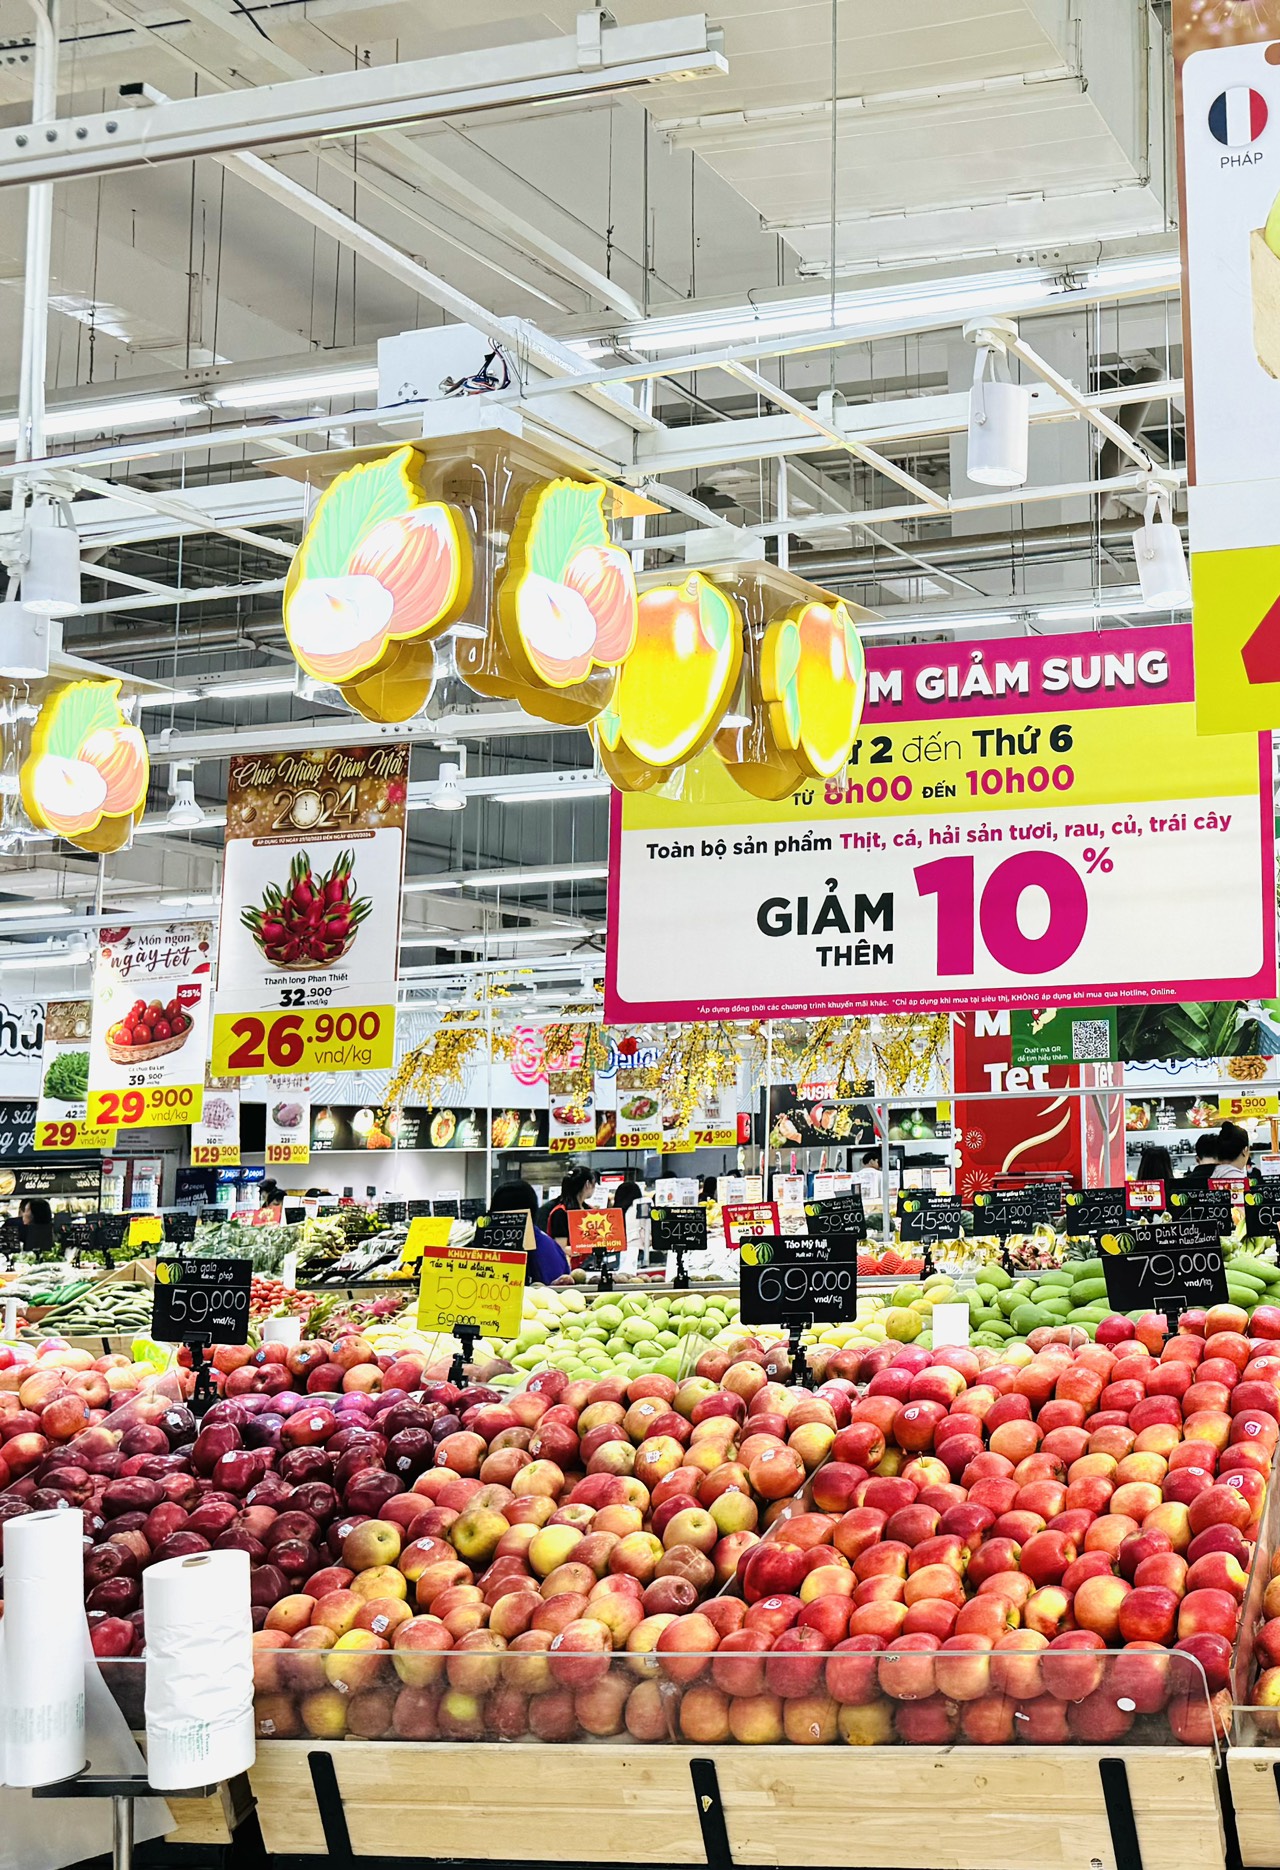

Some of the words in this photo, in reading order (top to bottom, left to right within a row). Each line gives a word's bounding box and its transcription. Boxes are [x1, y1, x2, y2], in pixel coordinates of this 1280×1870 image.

[1220, 150, 1263, 168] PHÁP
[916, 650, 1029, 700] GIẢM
[1042, 650, 1169, 691] SUNG
[870, 736, 893, 763] 2
[902, 731, 962, 763] đến
[972, 725, 1041, 757] Thứ
[1050, 724, 1073, 752] 6
[232, 759, 276, 787] Chúc
[328, 754, 367, 784] Năm
[792, 790, 814, 806] TỪ
[824, 775, 912, 805] 8h00
[922, 780, 956, 799] ĐẾN
[966, 764, 1074, 796] 10h00
[272, 784, 359, 831] 2024
[646, 841, 694, 859] Toàn
[701, 839, 727, 860] bộ
[733, 836, 768, 854] sản
[774, 830, 832, 856] phẩm
[840, 832, 887, 852] Thịt,
[893, 829, 922, 849] cá,
[929, 824, 960, 845] hải
[966, 823, 1002, 843] sản
[1010, 821, 1058, 842] tươi,
[1064, 823, 1105, 840] rau,
[1112, 814, 1143, 837] củ,
[1150, 813, 1187, 832] trái
[1194, 811, 1232, 832] cây
[756, 878, 894, 937] GIẢM
[913, 846, 1114, 977] 10%
[138, 935, 160, 946] Món
[164, 934, 190, 946] ngon
[816, 938, 894, 967] THÊM
[264, 978, 288, 986] Thanh
[288, 976, 306, 985] long
[178, 988, 201, 998] -25%
[279, 987, 332, 1008] 32.900
[768, 1002, 779, 1011] các
[1012, 992, 1040, 1001] KHÔNG
[1074, 990, 1085, 999] khi
[1104, 991, 1118, 1000] qua
[1120, 988, 1149, 997] Hotline,
[1150, 988, 1177, 996] Online.
[228, 1011, 381, 1069] 26.900
[314, 1044, 372, 1065] vnd/kg
[96, 1088, 194, 1125] 29.900
[151, 1108, 188, 1122] vnd/kg
[1230, 1098, 1266, 1114] 5.900
[550, 1136, 595, 1151] 479.000
[620, 1132, 660, 1146] 99.000
[694, 1130, 732, 1144] 74.900
[193, 1146, 238, 1164] 129.900
[268, 1145, 308, 1162] 199.000
[818, 1212, 863, 1234] 39.900
[911, 1211, 961, 1231] 45.900
[984, 1204, 1032, 1224] 54.900
[1078, 1204, 1123, 1226] 22.500
[1180, 1206, 1228, 1220] 47.500
[482, 1229, 523, 1247] 59.900
[660, 1222, 704, 1240] 54.900
[448, 1248, 482, 1260] KHUYẾN
[784, 1240, 800, 1249] Táo
[801, 1240, 814, 1250] Mỹ
[1126, 1252, 1220, 1288] 79.000
[435, 1276, 510, 1310] 59.000
[758, 1267, 852, 1302] 69.000
[170, 1288, 247, 1323] 59.000
[438, 1312, 476, 1327] 69.000
